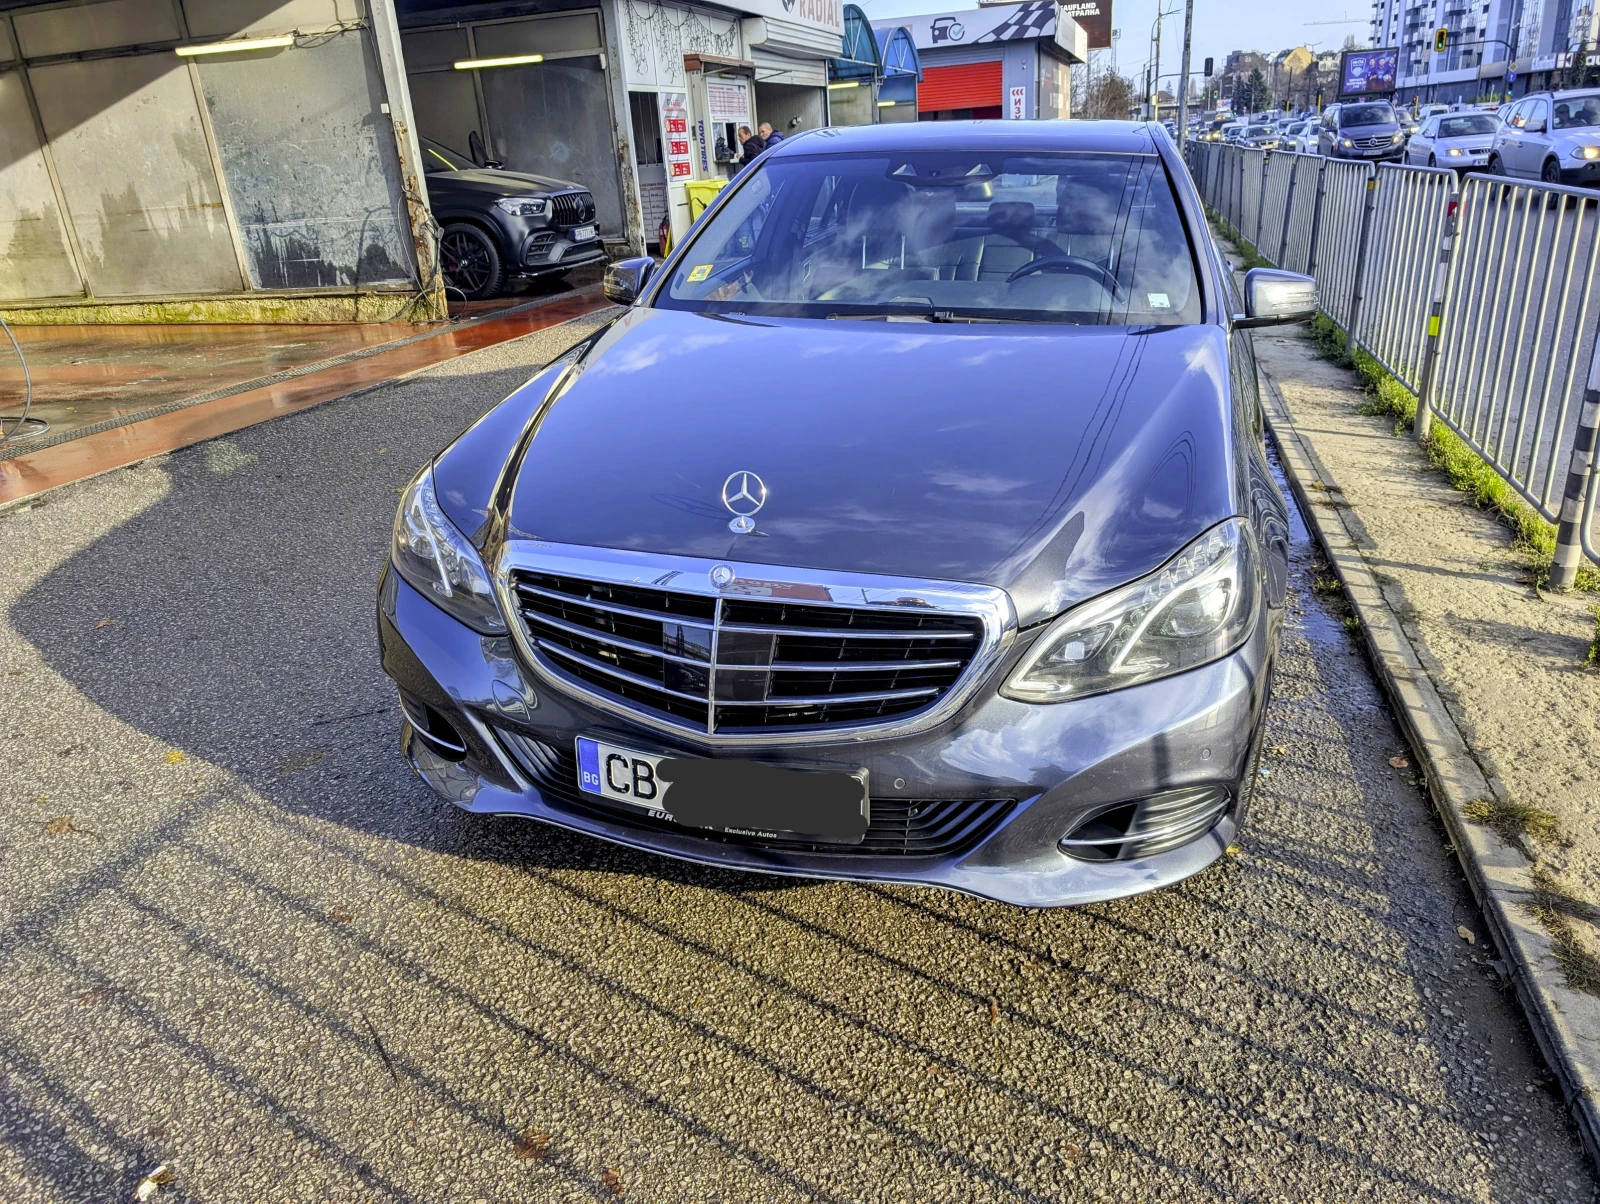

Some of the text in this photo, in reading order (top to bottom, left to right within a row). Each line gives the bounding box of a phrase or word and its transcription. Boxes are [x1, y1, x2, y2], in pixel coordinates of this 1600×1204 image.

[799, 0, 840, 28] RADIAL
[1060, 2, 1097, 12] AUFLAND
[698, 120, 708, 172] TOYO TIRES
[583, 771, 599, 786] BG
[605, 753, 659, 800] CB
[724, 826, 756, 837] Exclusive
[757, 830, 778, 839] Autos
